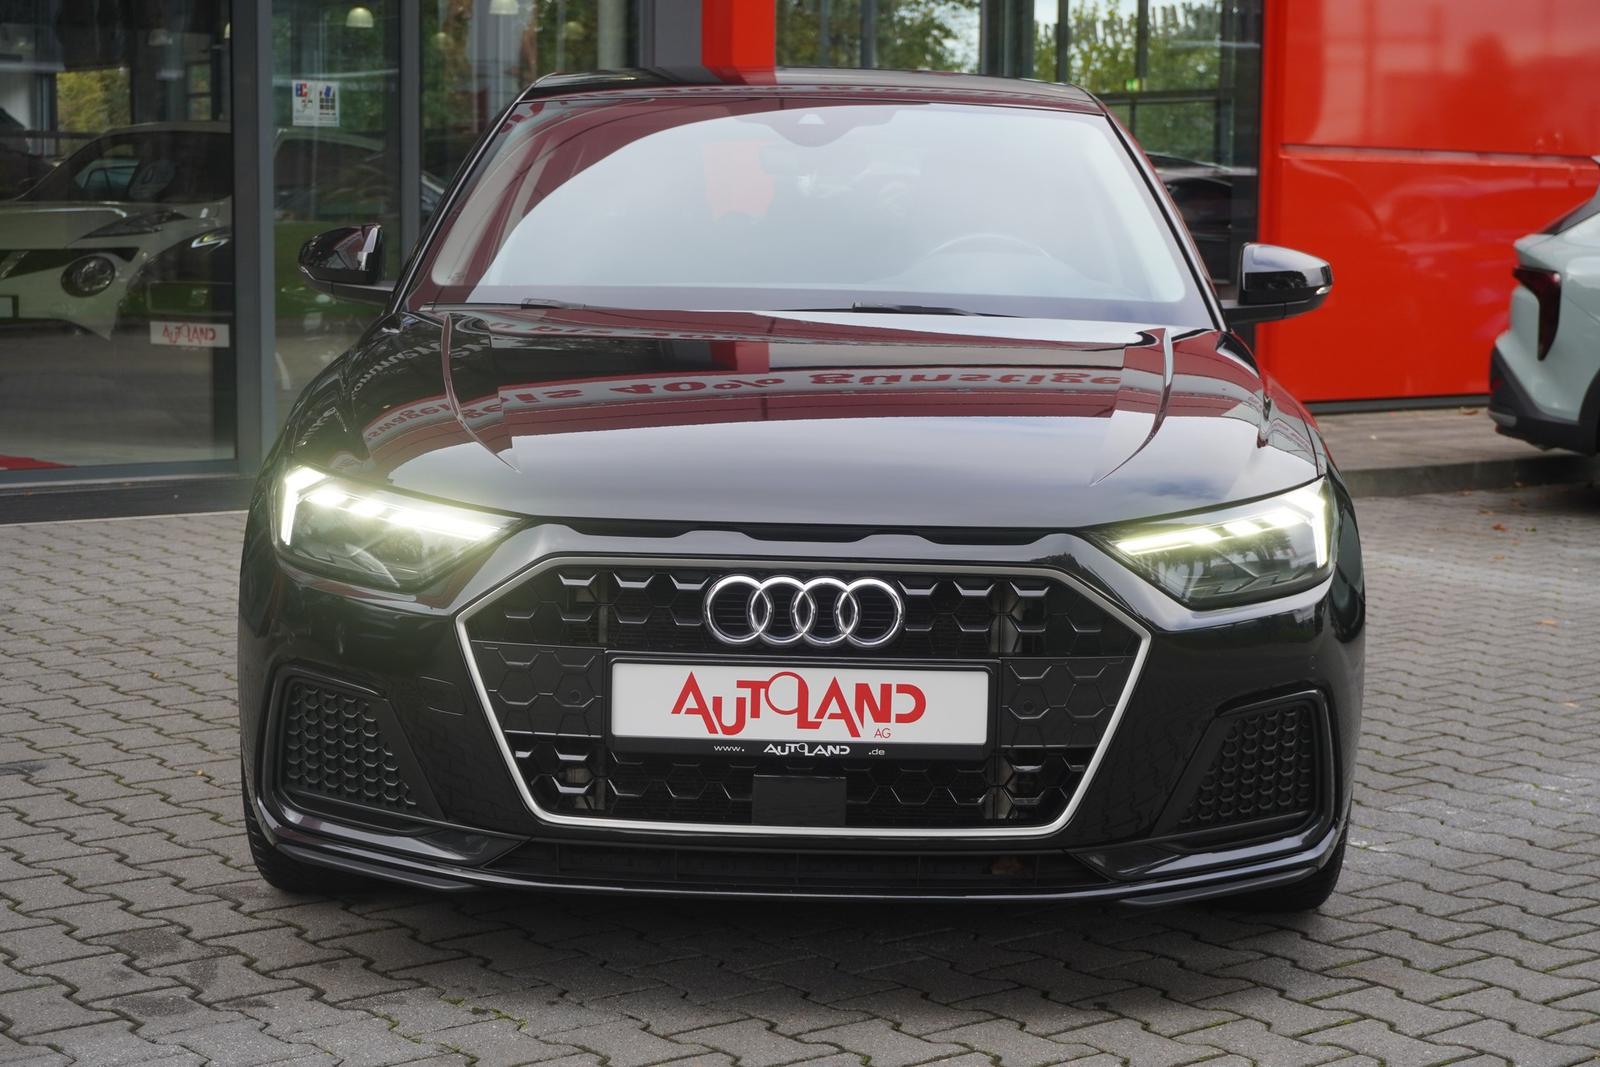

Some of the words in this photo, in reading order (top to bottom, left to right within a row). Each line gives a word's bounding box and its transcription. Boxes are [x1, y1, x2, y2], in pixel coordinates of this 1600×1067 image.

[671, 671, 927, 737] AUTOLAND
[874, 727, 892, 739] AG
[763, 743, 850, 756] AUTOLAND
[868, 748, 886, 756] .de
